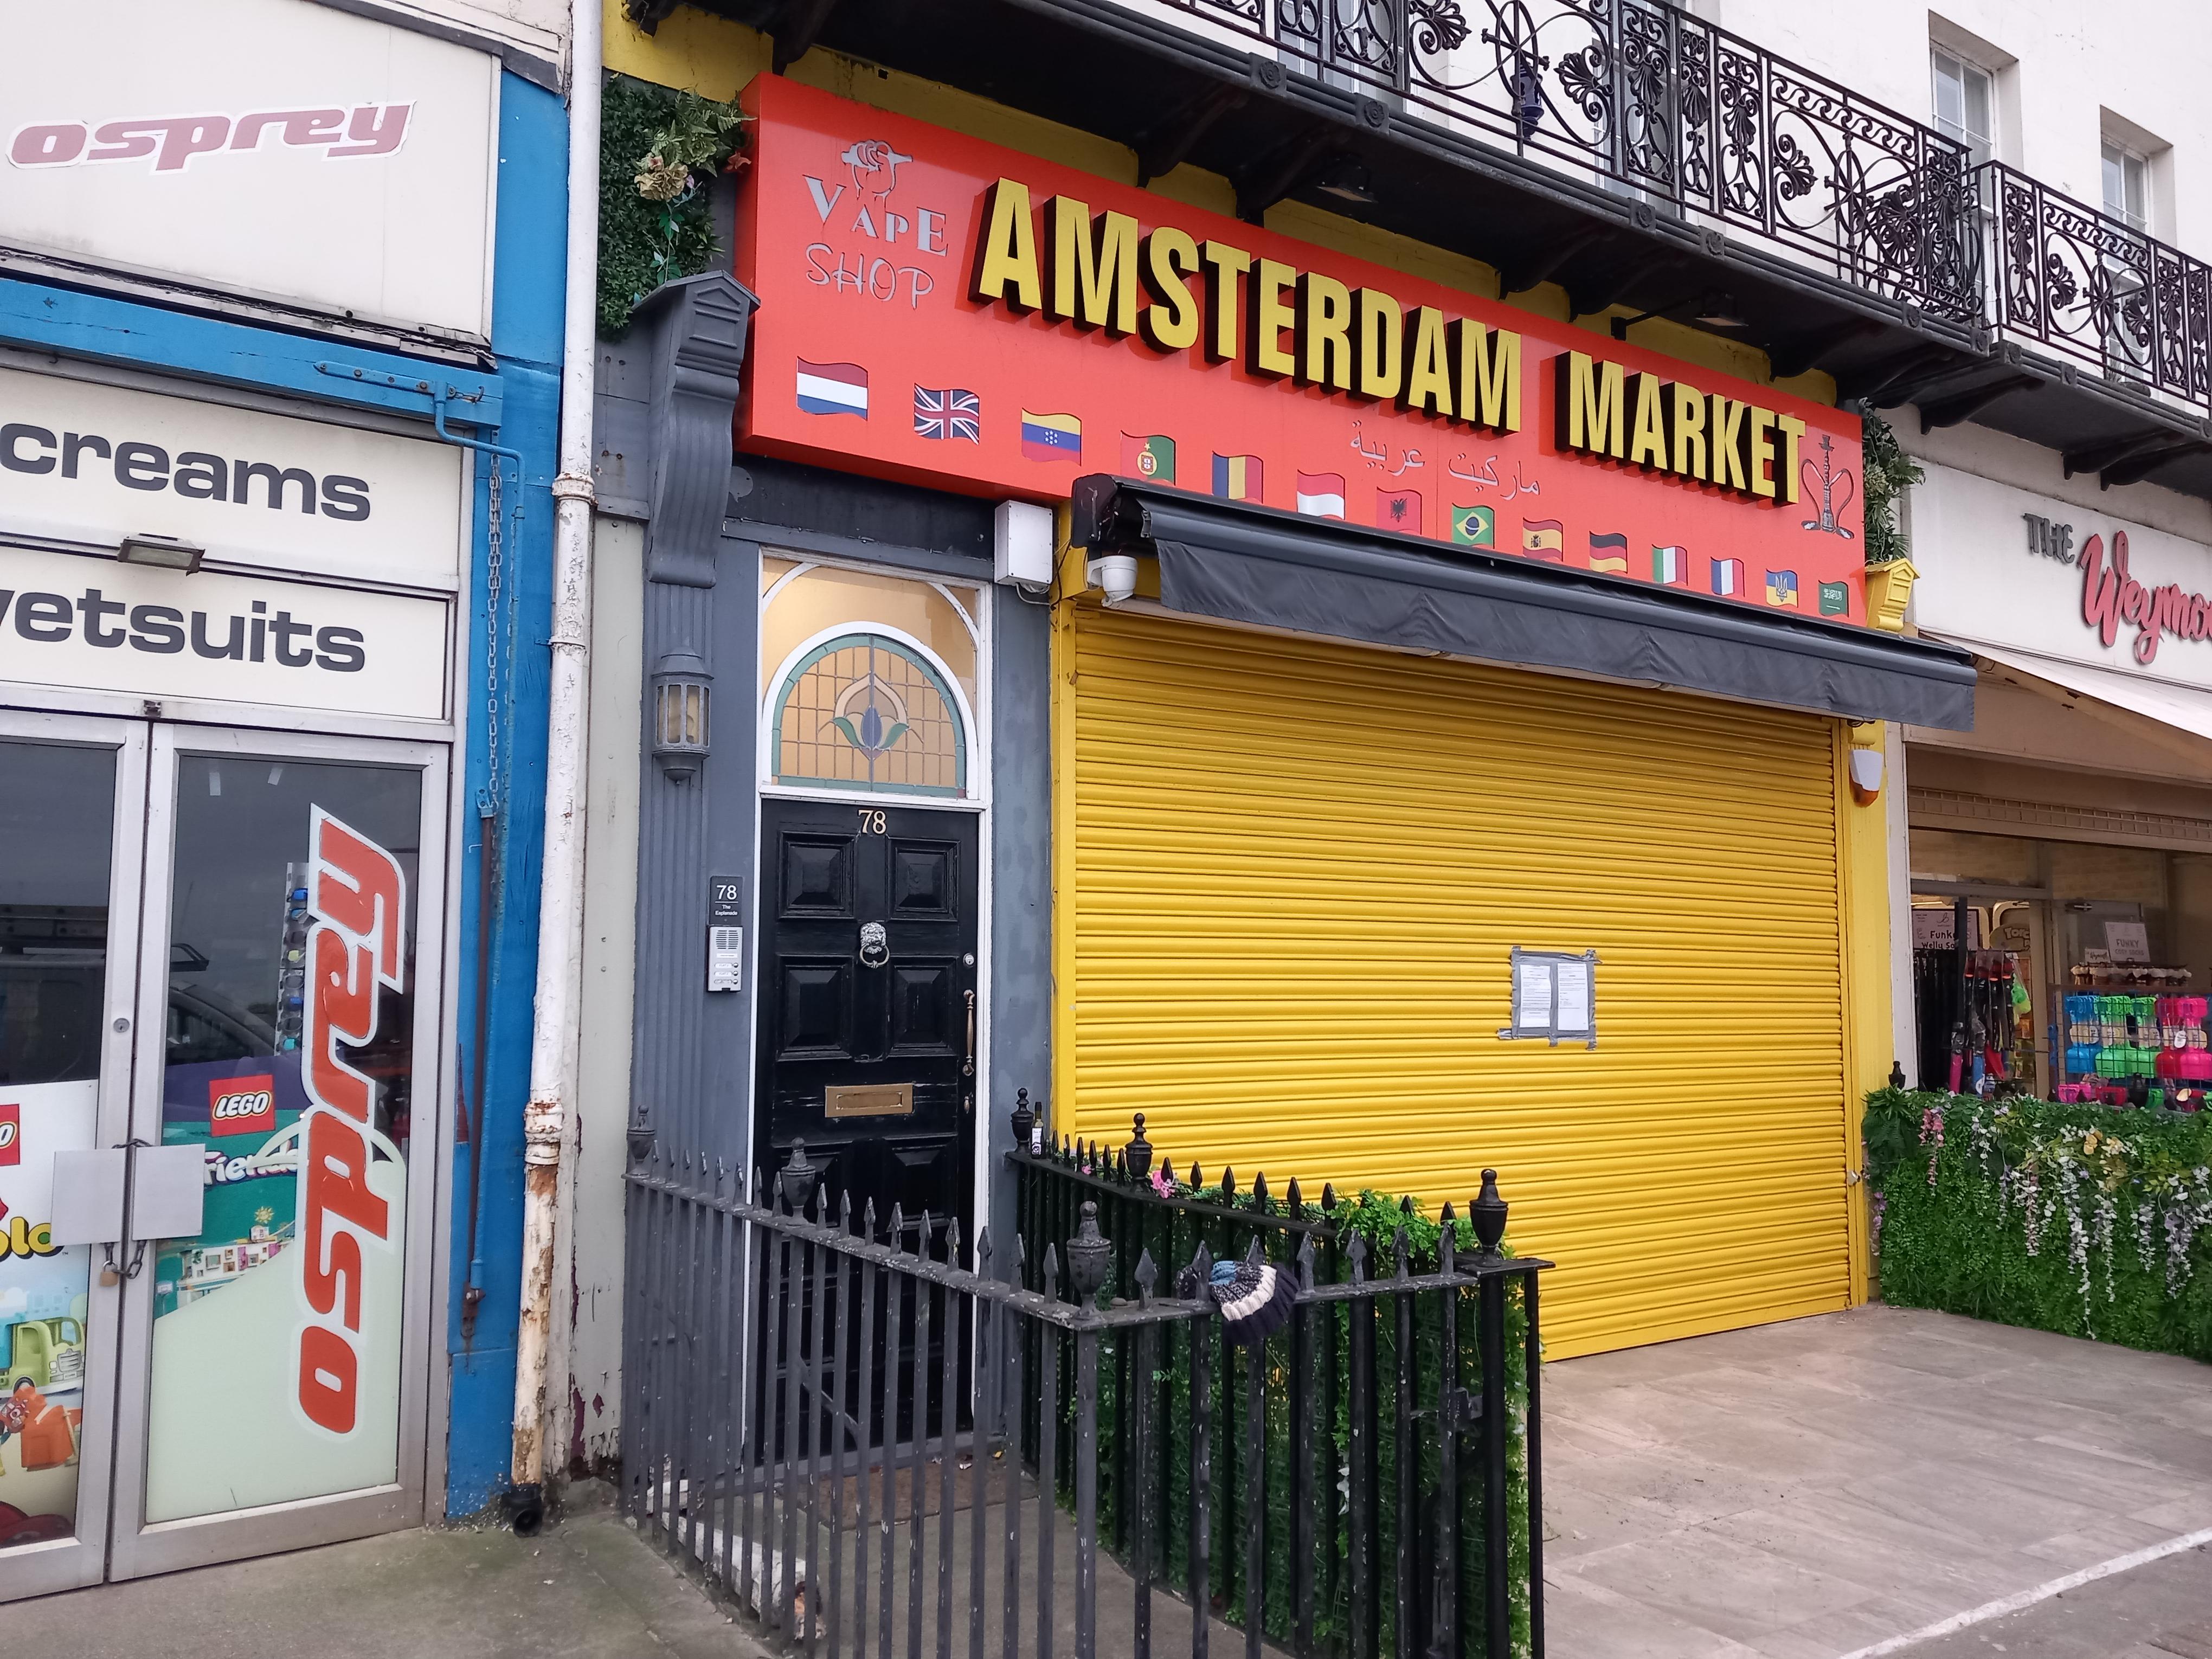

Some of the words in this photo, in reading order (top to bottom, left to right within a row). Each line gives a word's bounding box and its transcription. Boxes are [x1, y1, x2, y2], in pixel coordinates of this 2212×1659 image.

[10, 103, 416, 172] osprey
[802, 175, 948, 257] VAPE
[806, 242, 934, 309] SHOP
[973, 177, 1521, 434] AMSTERDAM
[1565, 350, 1806, 505] MARKET
[0, 422, 371, 522] creams
[2023, 513, 2075, 563] THE
[2078, 530, 2212, 665] Weymo
[858, 809, 887, 834] 78
[716, 884, 737, 900] 78
[1930, 930, 1956, 940] Funk
[215, 1091, 271, 1119] LEGO
[298, 817, 400, 1435] osprey
